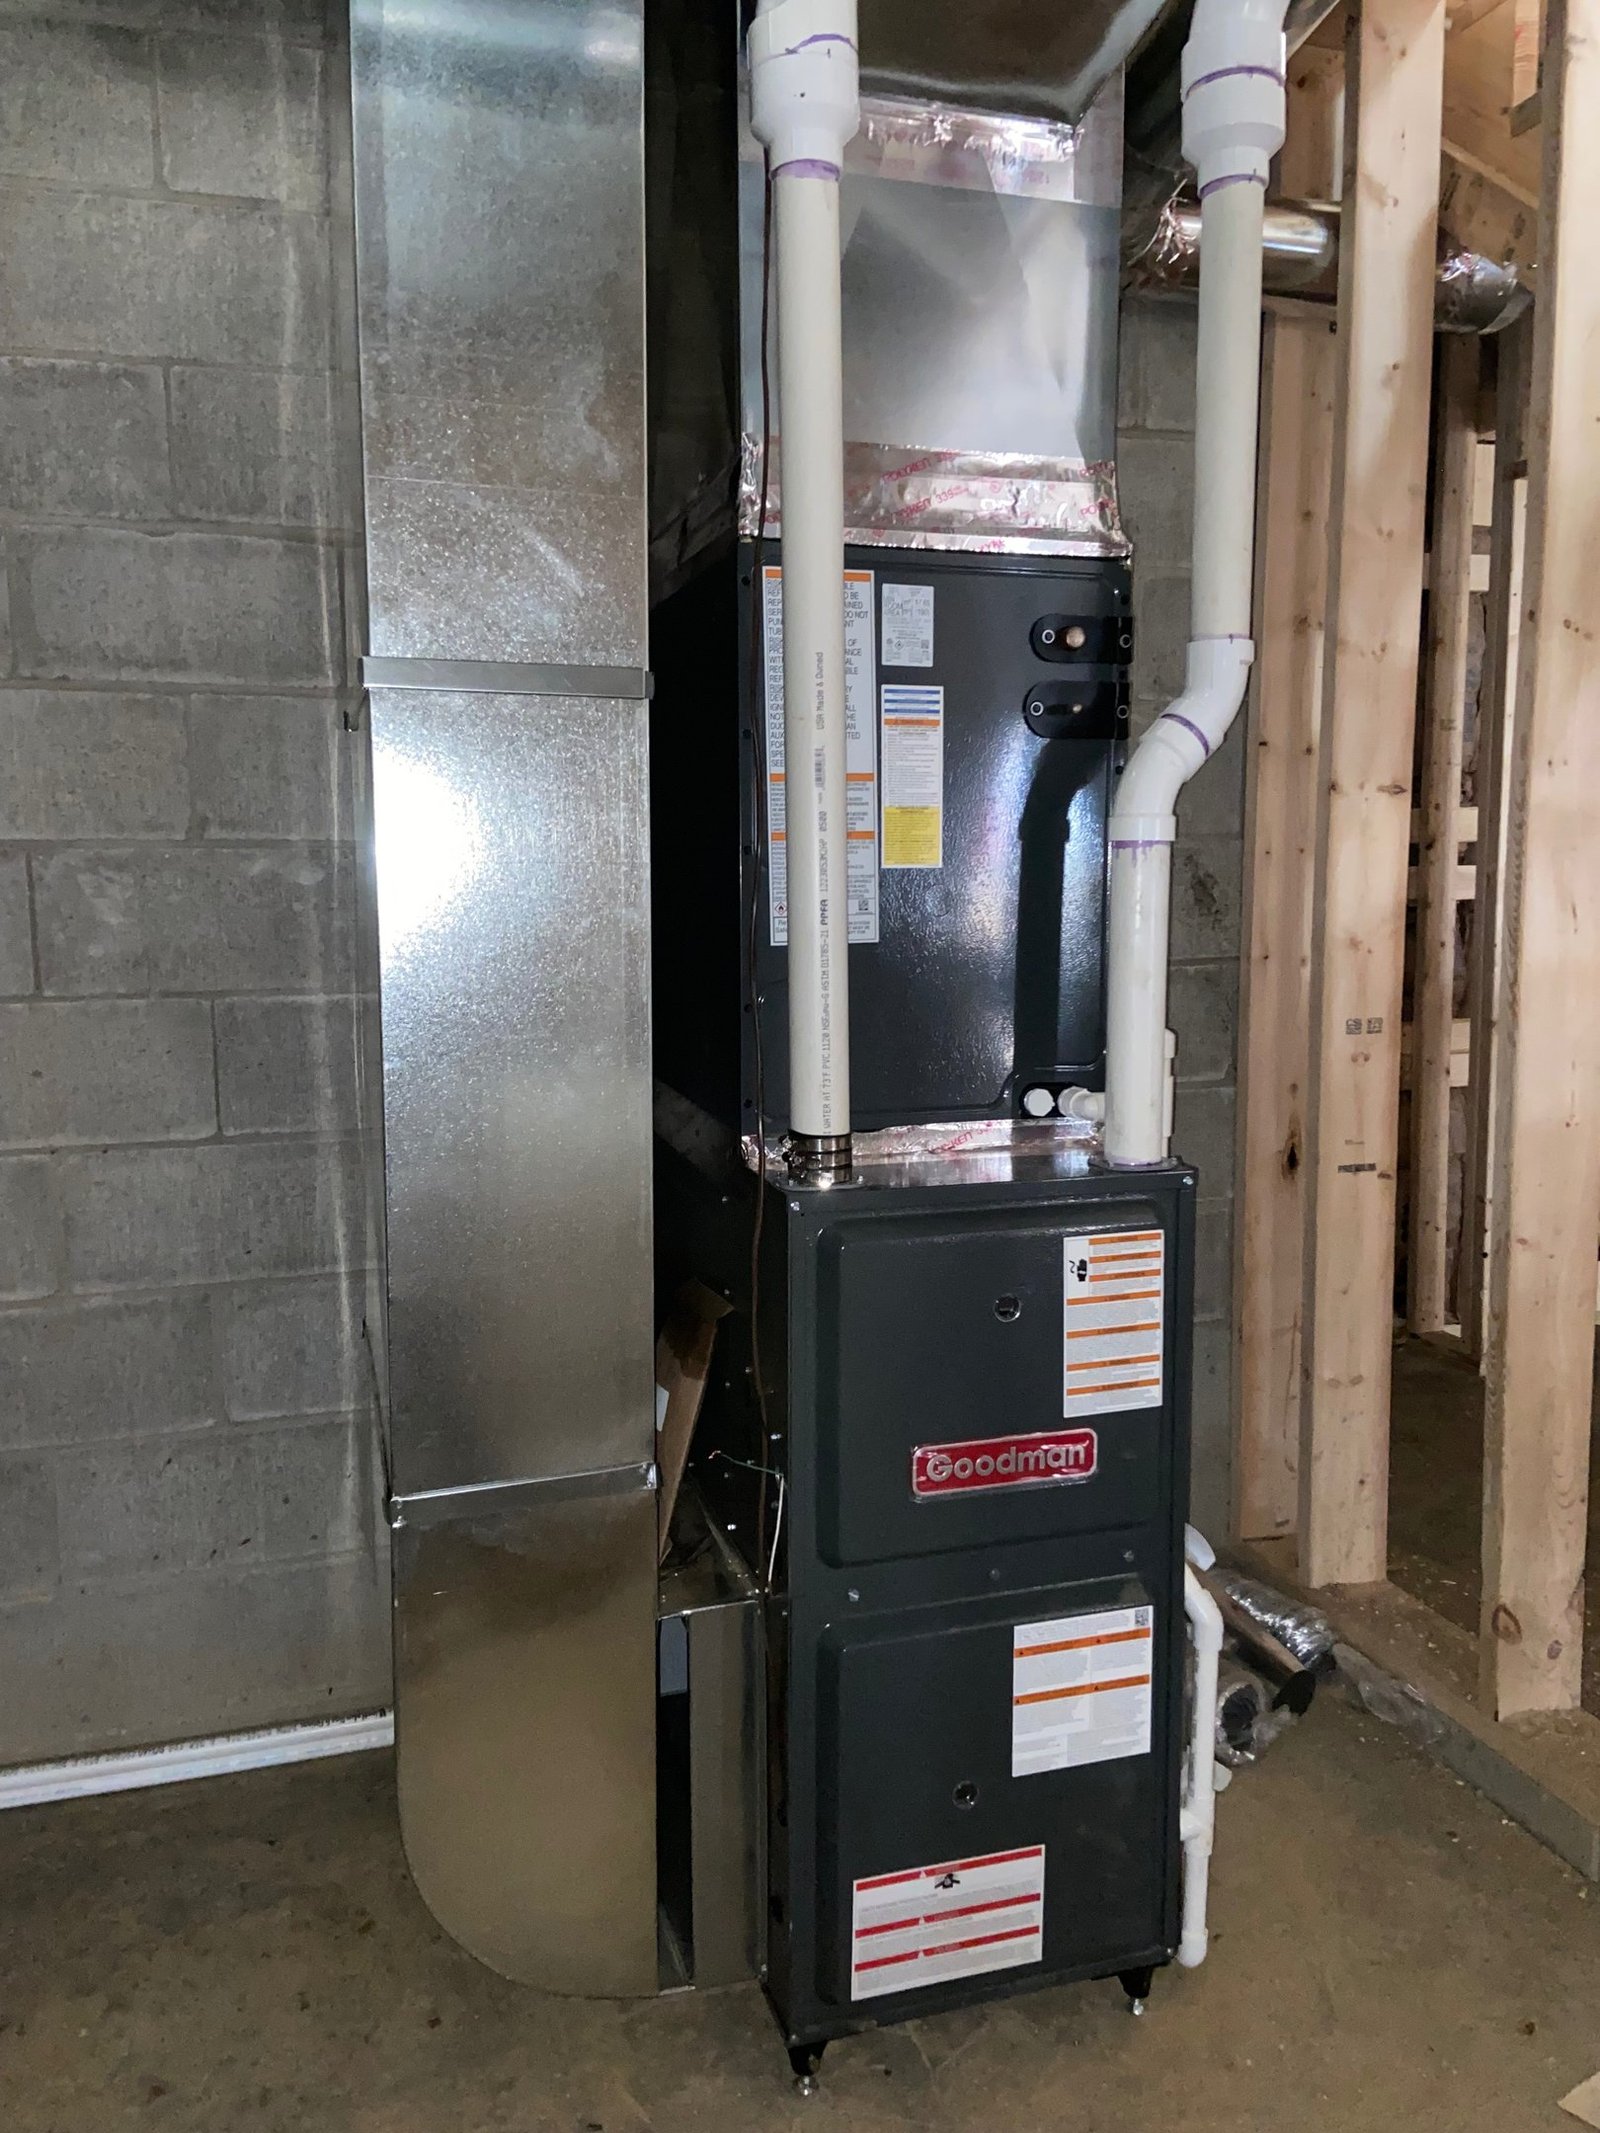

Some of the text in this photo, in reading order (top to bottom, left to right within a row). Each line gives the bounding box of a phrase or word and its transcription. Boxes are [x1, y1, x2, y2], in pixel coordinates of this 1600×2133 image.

[814, 651, 824, 680] Owned
[815, 689, 824, 711] Made
[815, 713, 825, 730] USA
[819, 899, 829, 926] PPFA
[821, 1053, 830, 1070] PVC
[822, 1103, 831, 1129] WATER
[926, 1445, 1085, 1482] Goodman
